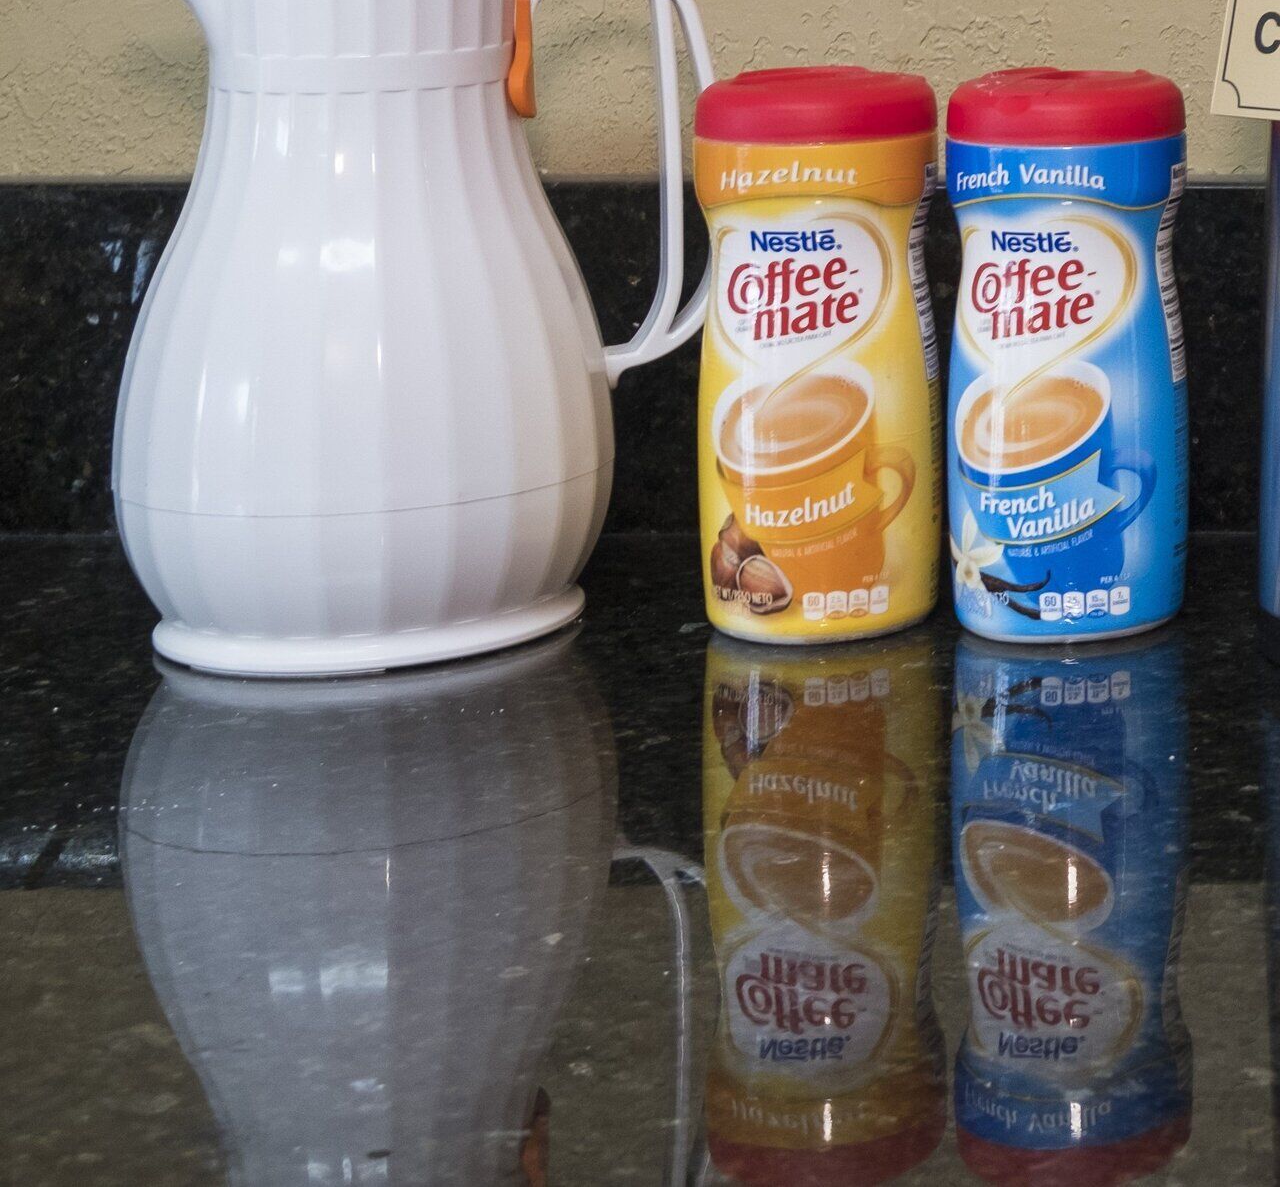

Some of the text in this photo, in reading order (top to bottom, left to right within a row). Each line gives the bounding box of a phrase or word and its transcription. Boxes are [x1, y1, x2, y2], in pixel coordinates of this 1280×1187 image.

[720, 161, 858, 192] Hazelnut
[956, 163, 1106, 192] French Vanilla
[753, 291, 859, 341] mate
[991, 292, 1094, 341] mate
[745, 482, 856, 528] Hazelnut
[980, 486, 1056, 515] French
[1006, 497, 1095, 539] Vanilla
[1044, 596, 1057, 607] 60
